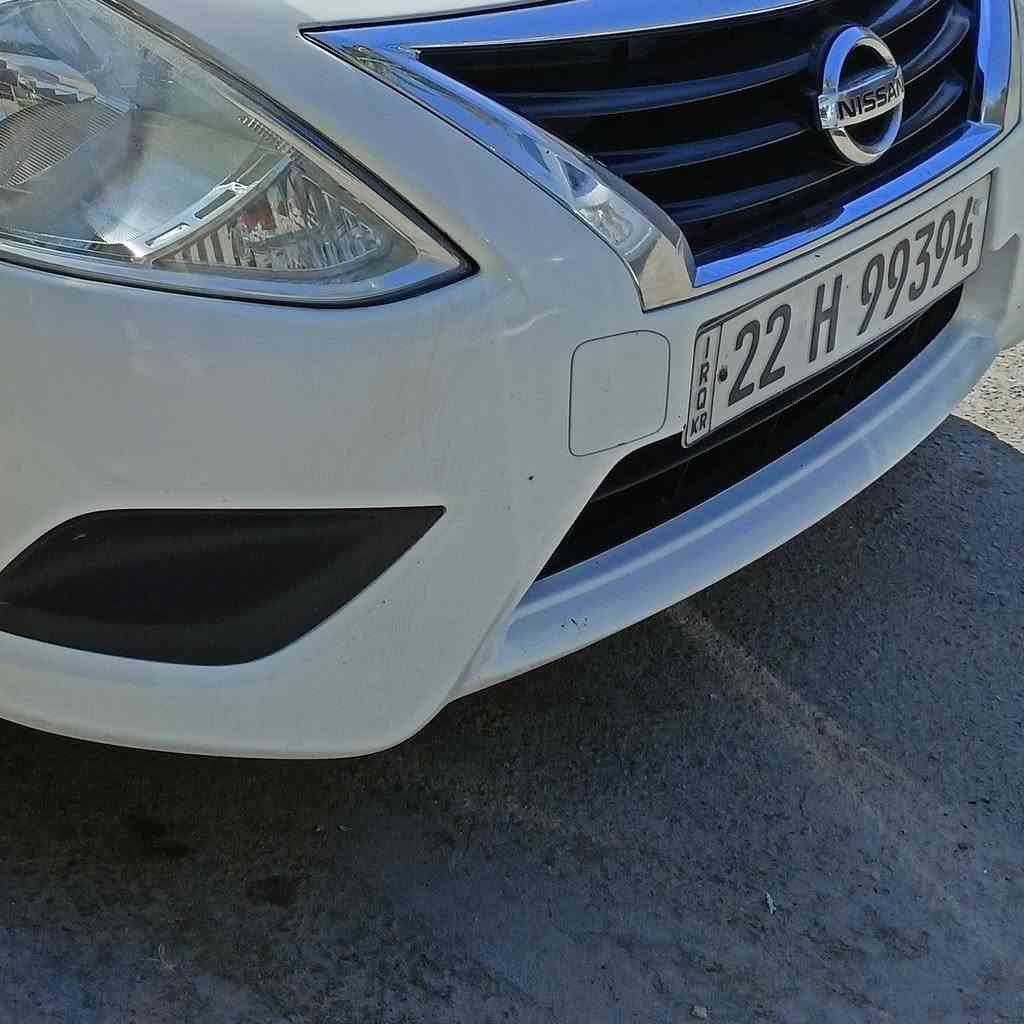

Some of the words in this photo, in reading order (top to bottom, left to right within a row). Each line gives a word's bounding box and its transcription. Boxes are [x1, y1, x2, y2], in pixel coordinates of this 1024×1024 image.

[838, 79, 904, 120] NISSAN
[728, 303, 791, 406] 22
[808, 274, 843, 363] H
[857, 196, 975, 336] 99394
[690, 412, 707, 436] KR
